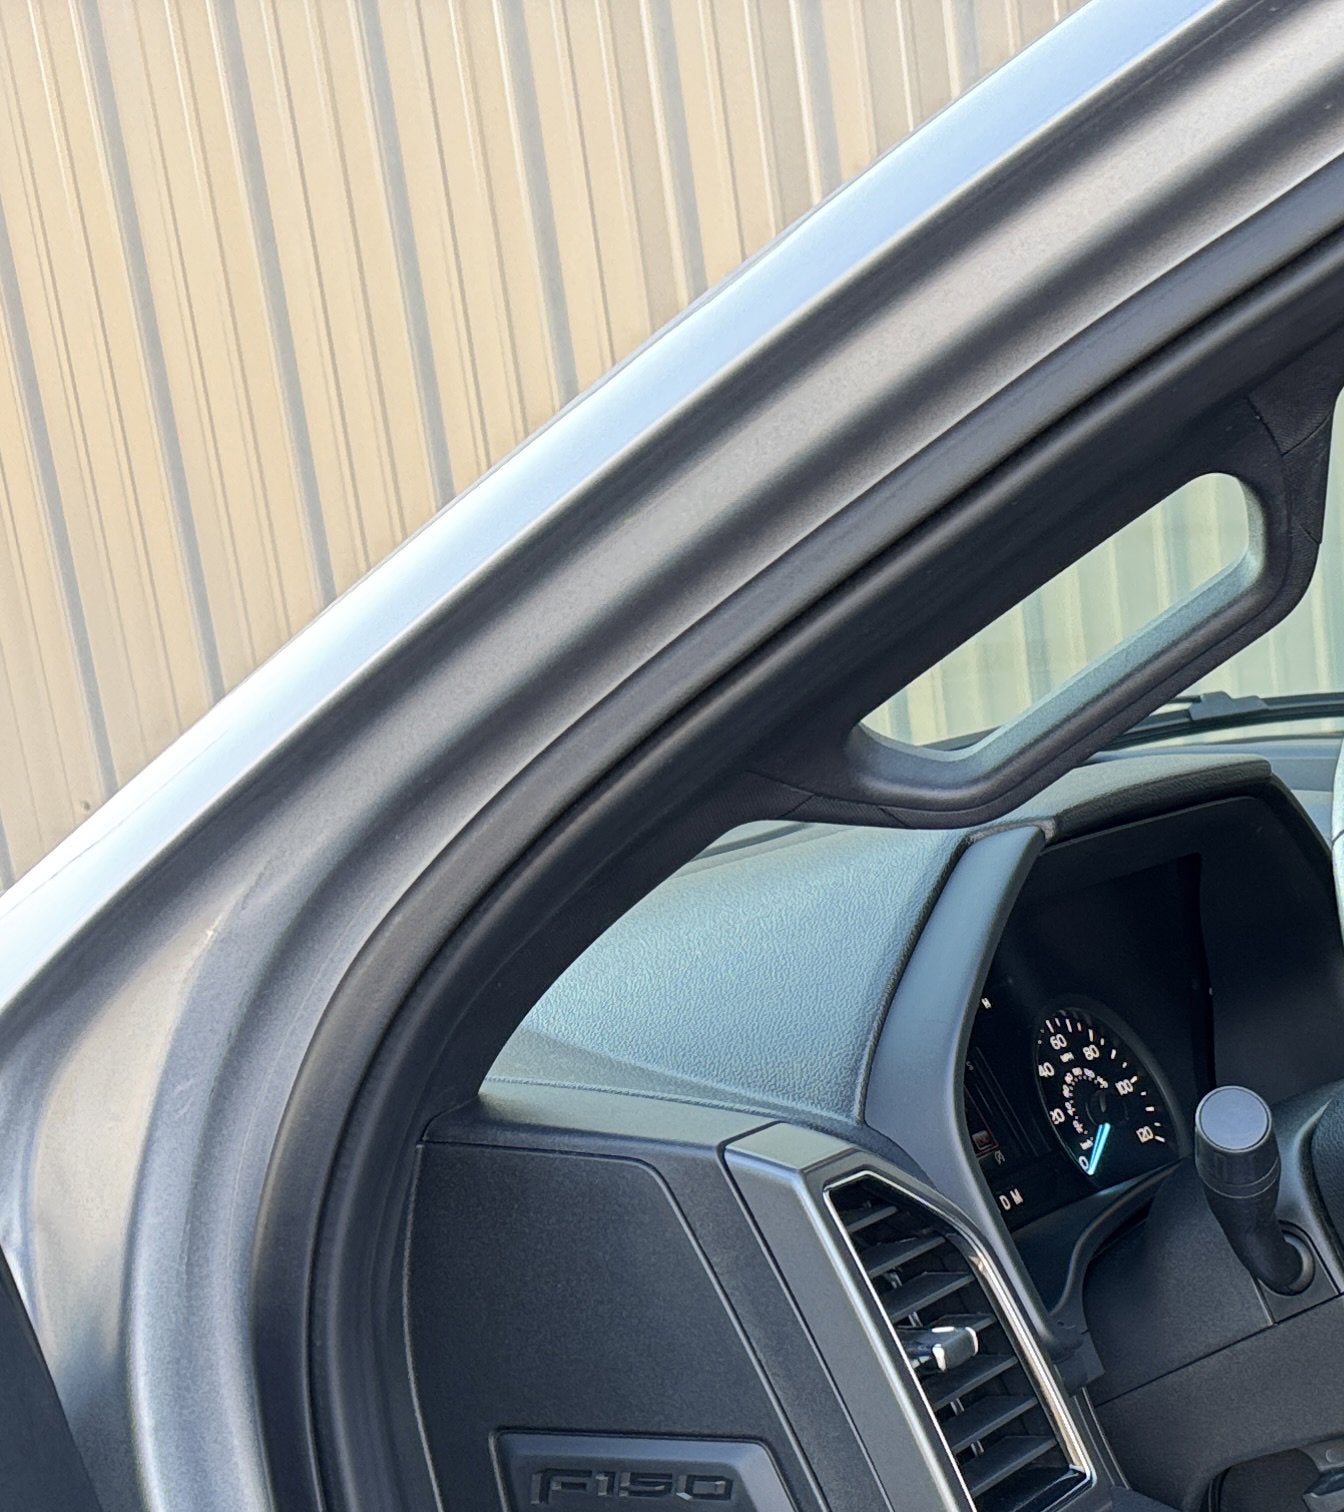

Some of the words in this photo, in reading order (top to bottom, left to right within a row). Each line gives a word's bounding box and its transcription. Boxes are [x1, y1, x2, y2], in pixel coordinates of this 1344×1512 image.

[1050, 1034, 1067, 1050] 60
[1083, 1045, 1099, 1060] 80
[1038, 1062, 1055, 1078] 40
[1115, 1079, 1134, 1096] 100
[1050, 1108, 1065, 1125] 20
[1136, 1126, 1154, 1143] 120
